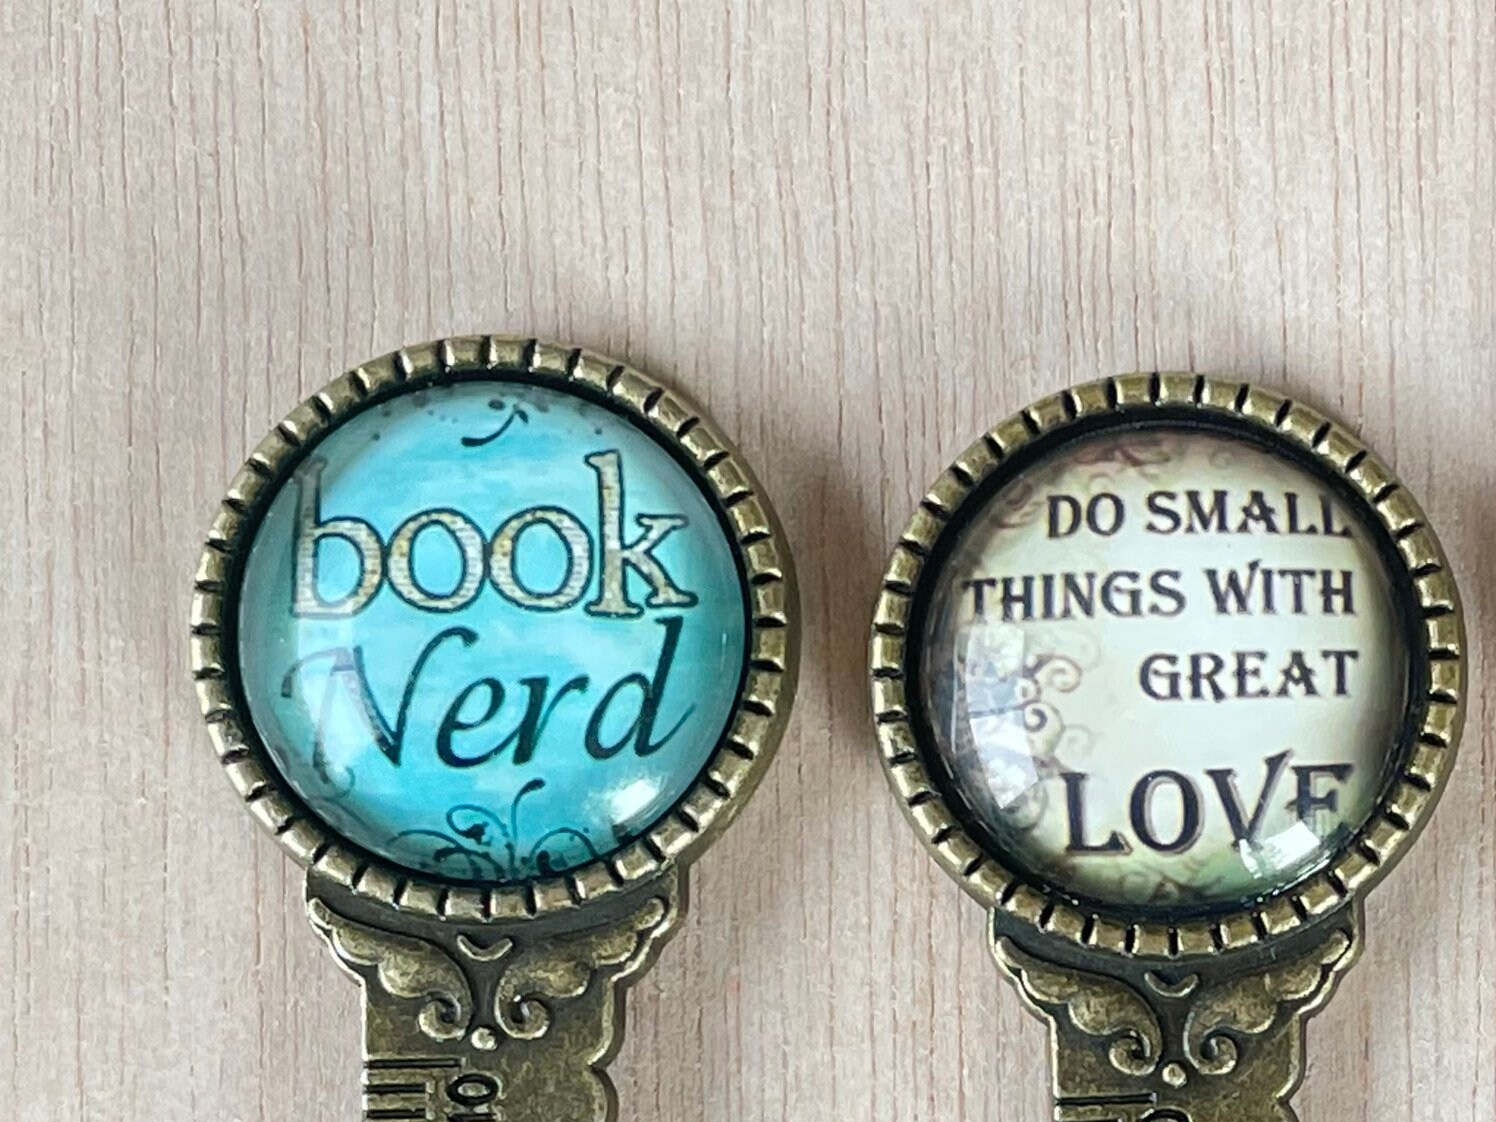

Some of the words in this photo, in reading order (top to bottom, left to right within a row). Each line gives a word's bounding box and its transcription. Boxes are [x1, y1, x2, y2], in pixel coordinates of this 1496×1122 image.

[290, 448, 698, 620] book
[1045, 490, 1126, 539] DO
[1145, 488, 1354, 539] SMALL
[962, 568, 1187, 622] THINGS
[1202, 557, 1358, 618] WITH
[281, 614, 697, 798] Nerd
[1139, 648, 1359, 703] GREAT
